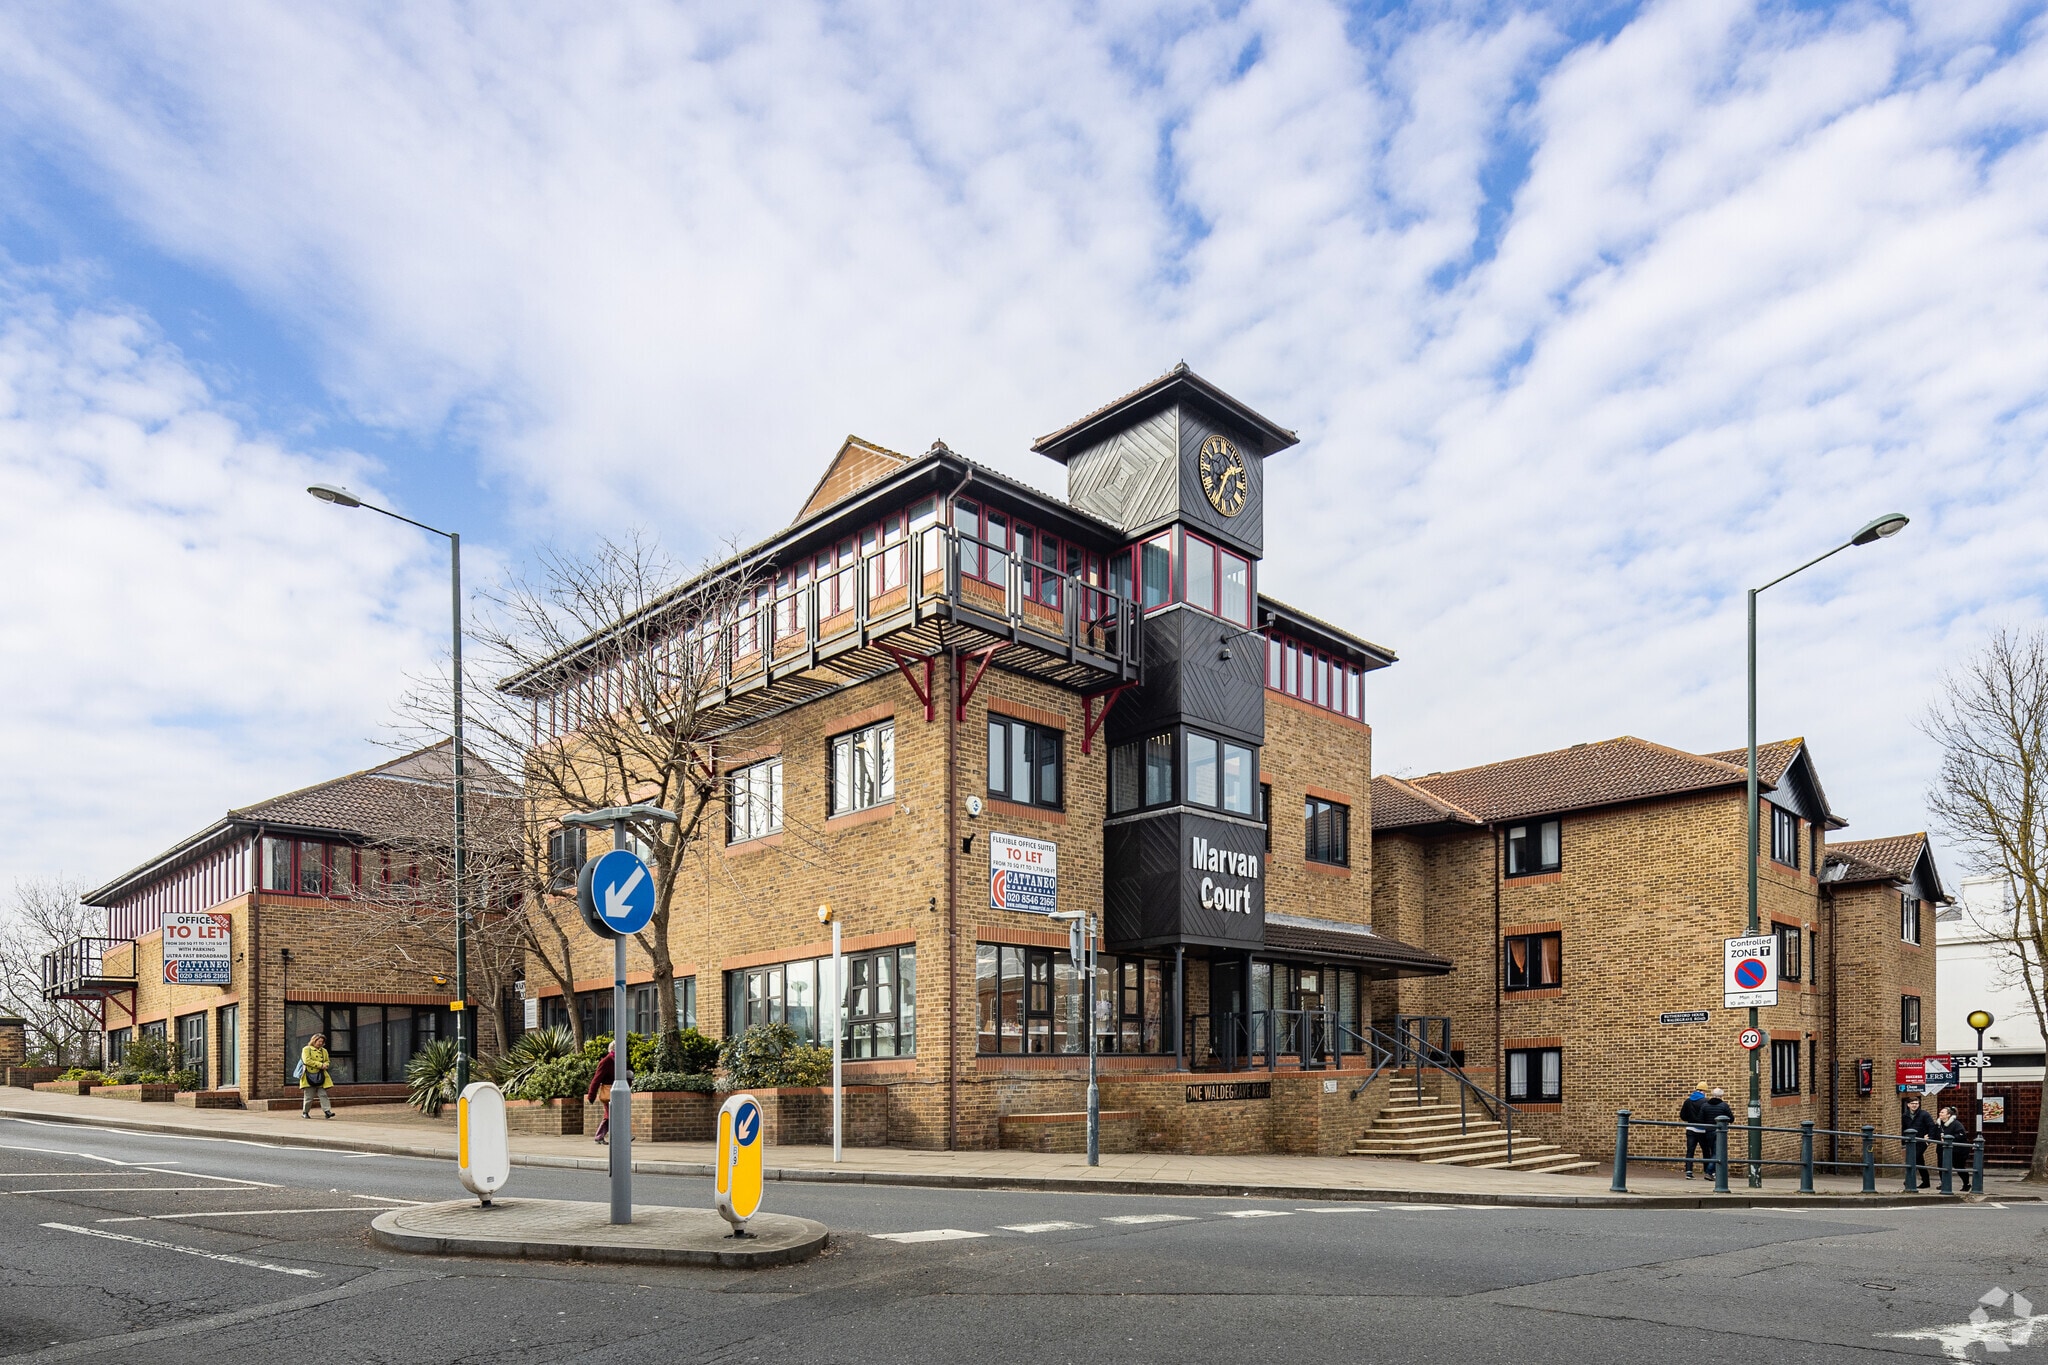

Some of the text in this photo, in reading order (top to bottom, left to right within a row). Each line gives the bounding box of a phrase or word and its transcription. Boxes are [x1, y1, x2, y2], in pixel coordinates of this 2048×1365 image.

[993, 836, 1054, 852] FLEXIBLE OFFICE SUITES
[1007, 848, 1042, 864] TO LET
[1192, 836, 1258, 878] Marvan
[1007, 872, 1054, 889] CATTANEO
[1007, 884, 1054, 895] COMMERCIAL
[1201, 877, 1250, 914] Court
[1007, 893, 1054, 906] 020 8546 2166
[177, 916, 215, 924] OFFICES
[167, 926, 224, 938] TO LET
[1731, 938, 1771, 947] Controlled
[1731, 946, 1770, 957] ZONE T
[1743, 1035, 1757, 1043] 20
[1951, 1057, 1991, 1067] ESS
[1187, 1083, 1270, 1100] ONE WALDEGRAVE ROAD
